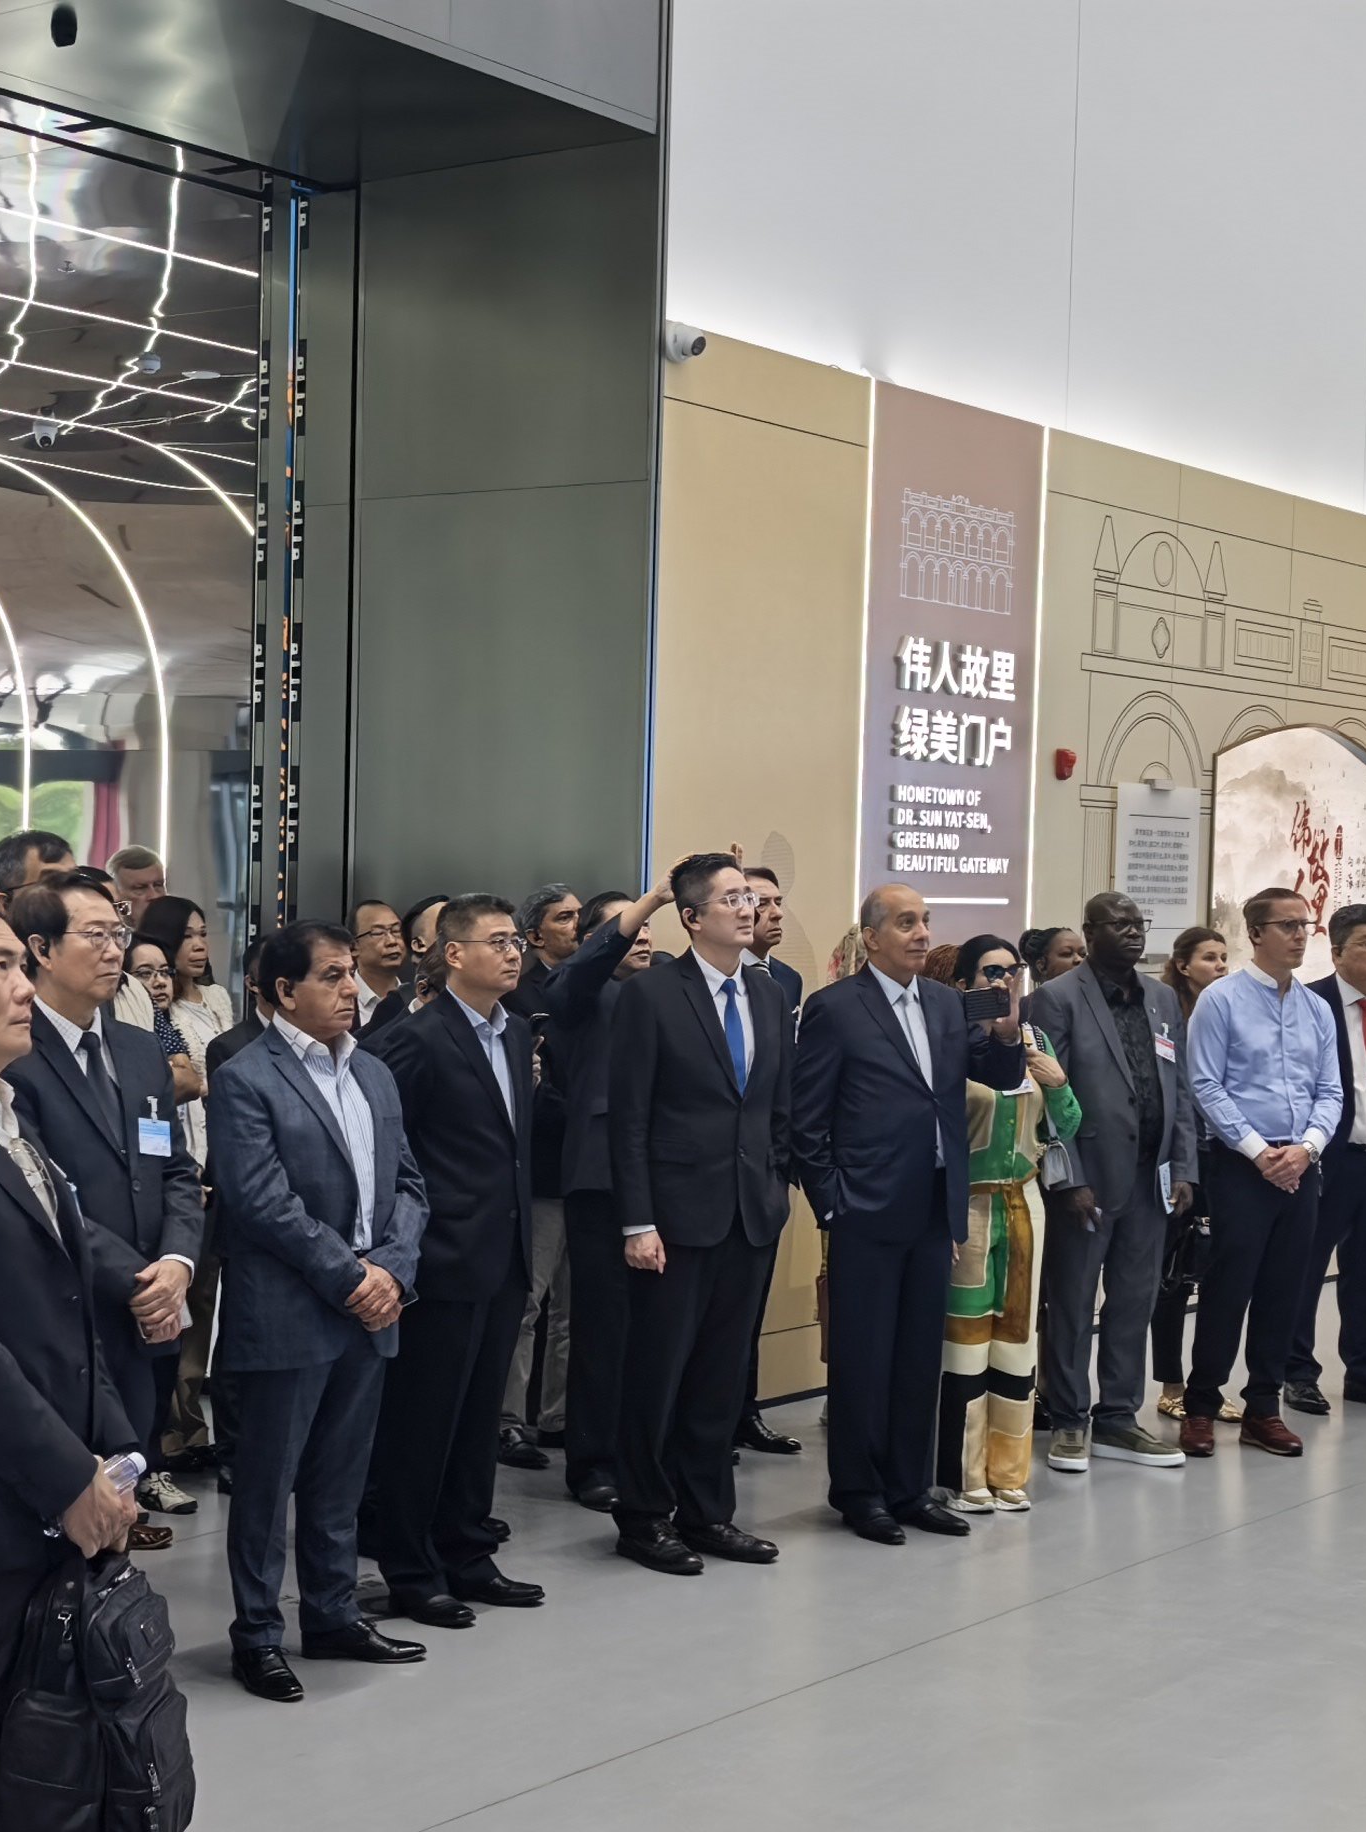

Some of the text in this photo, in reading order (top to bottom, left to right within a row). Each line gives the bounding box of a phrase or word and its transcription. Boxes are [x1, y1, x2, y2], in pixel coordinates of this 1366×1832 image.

[900, 636, 1016, 701] 伟人故里
[898, 706, 1013, 767] 绿美门户
[897, 785, 983, 807] HOMETOWN OF
[897, 808, 993, 834] DR. SUN YAT-SEN,
[896, 832, 960, 850] GREEN AND
[895, 854, 1010, 874] BEAUTIFUL GATEWAY
